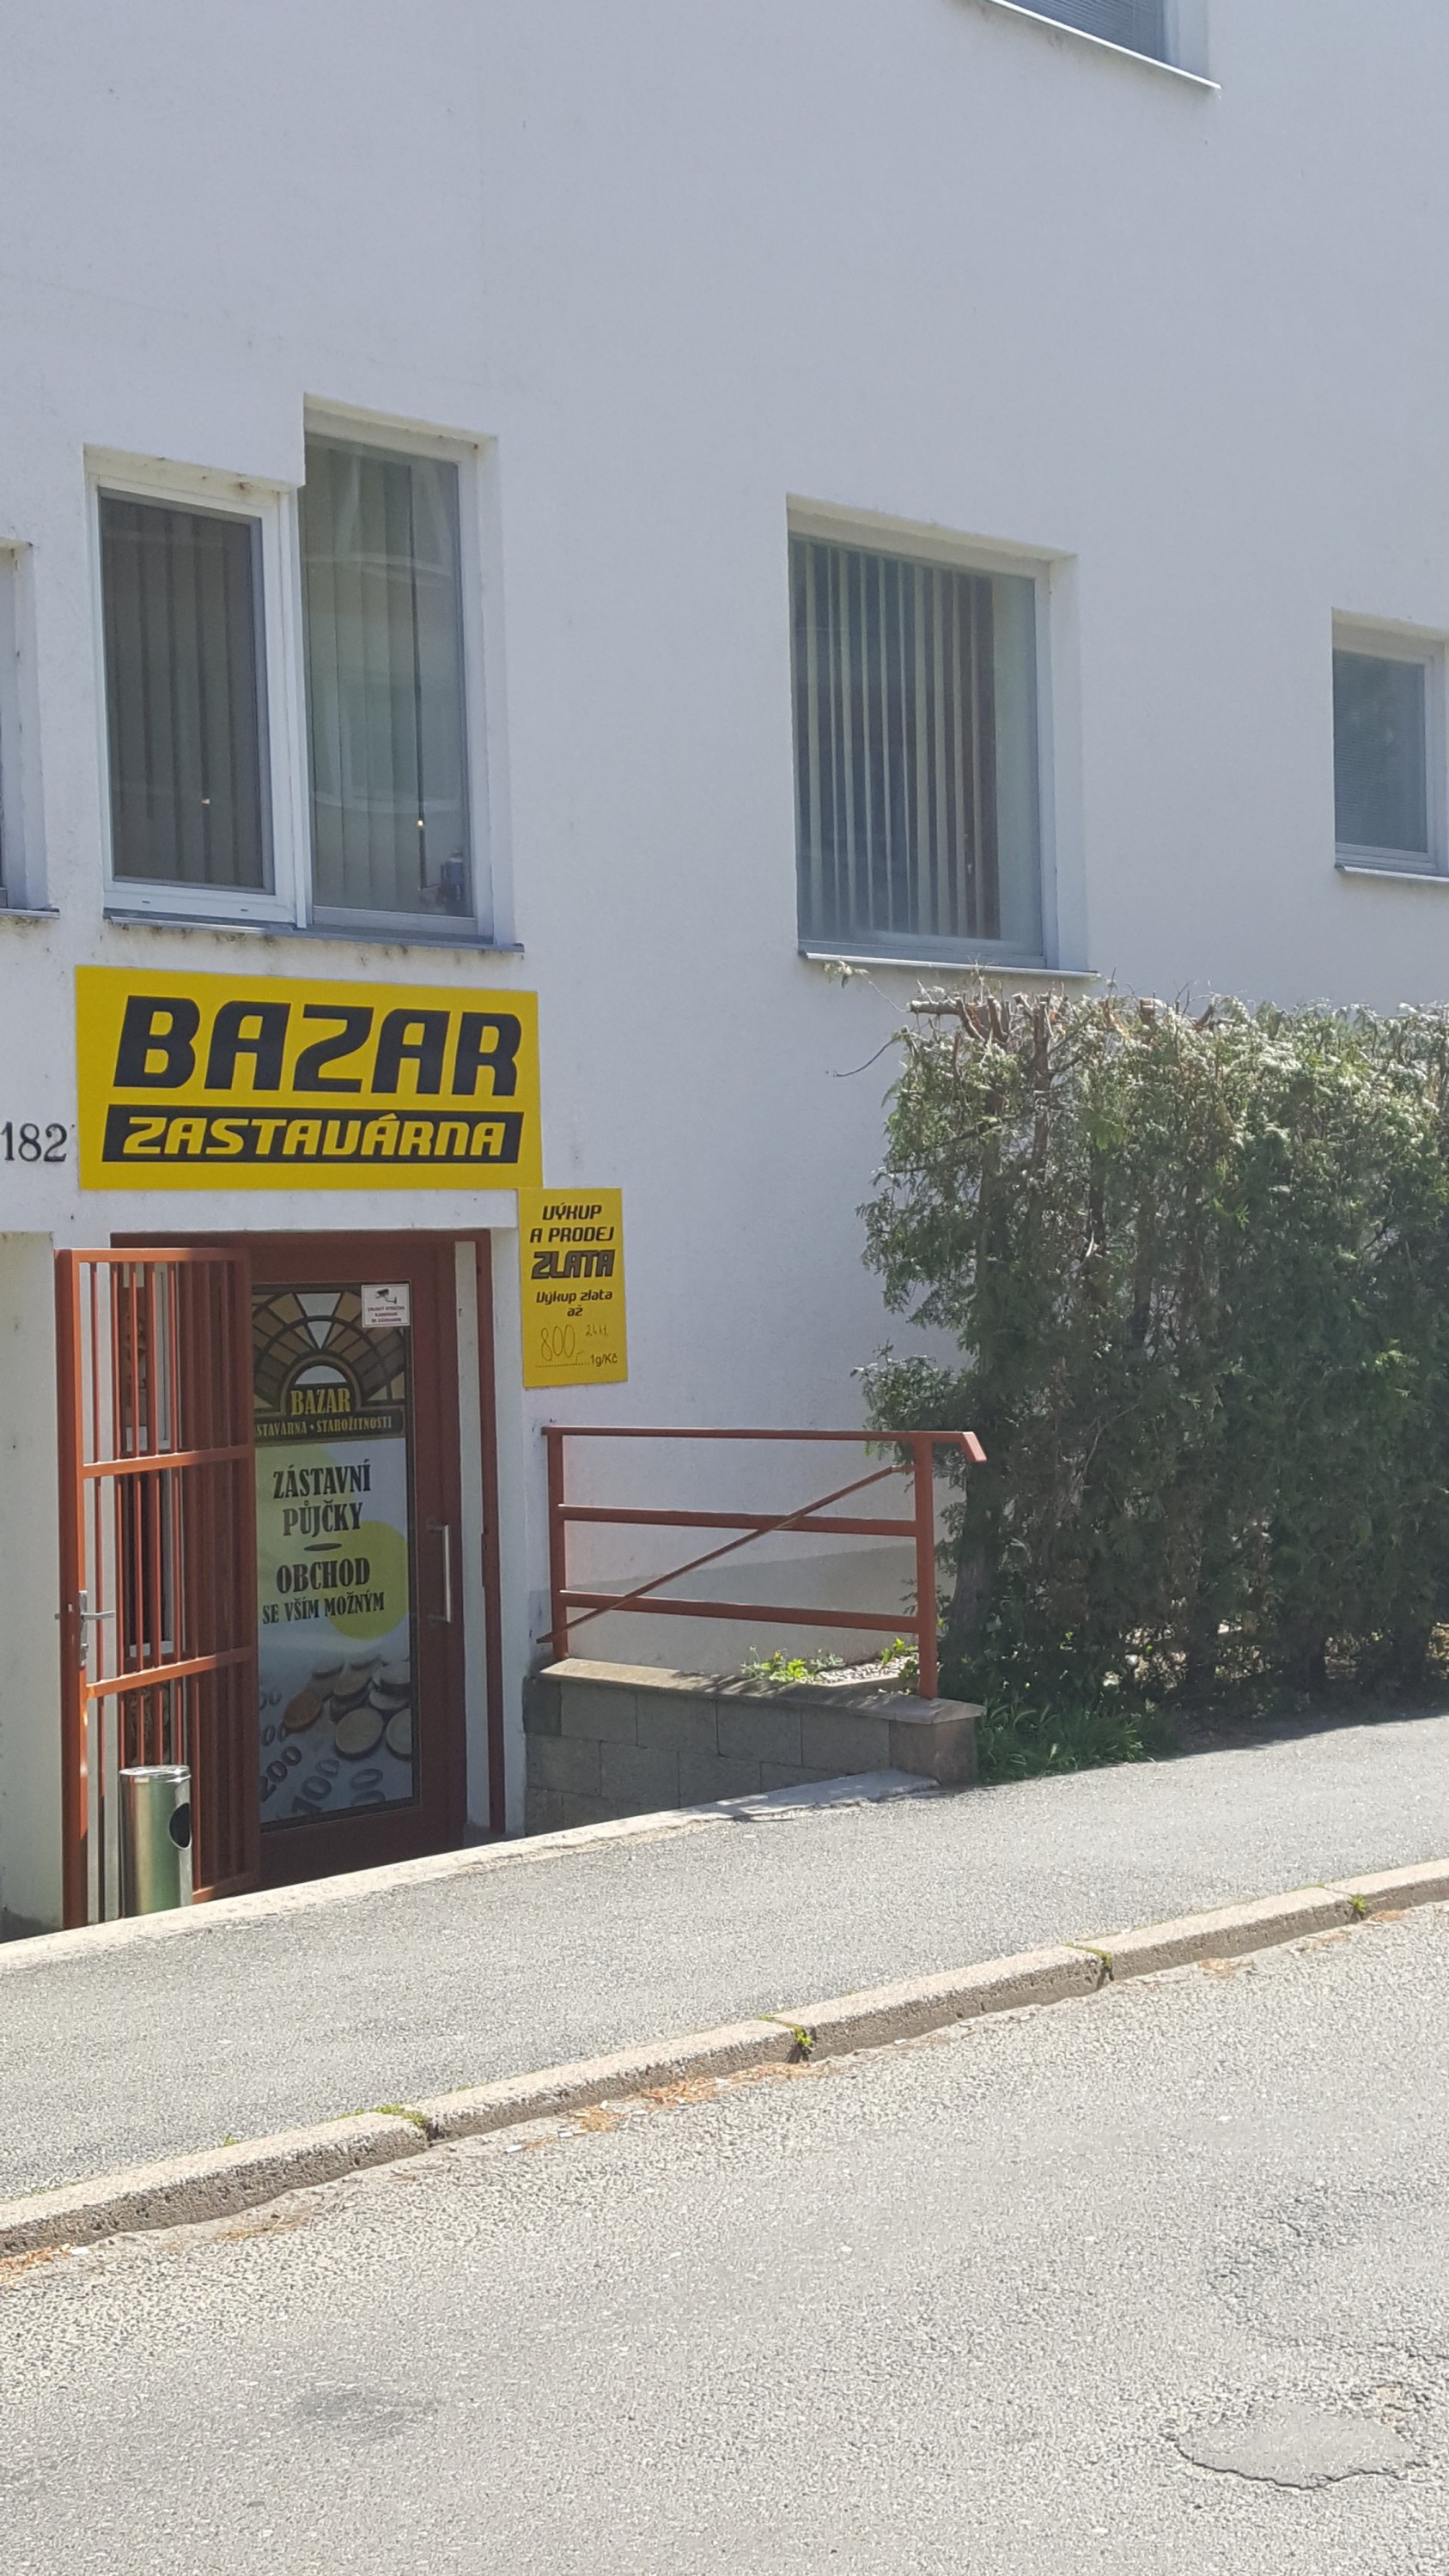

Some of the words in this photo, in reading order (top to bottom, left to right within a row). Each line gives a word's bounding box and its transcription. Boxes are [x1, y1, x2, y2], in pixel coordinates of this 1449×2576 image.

[113, 994, 522, 1097] BAZAR
[0, 1121, 67, 1162] 182
[122, 1113, 506, 1156] ZASTAVÁRNA
[542, 1202, 602, 1220] VÝKUP
[529, 1228, 543, 1243] A
[548, 1226, 615, 1242] PRODEJ
[531, 1249, 616, 1279] ZLATA
[536, 1290, 577, 1305] Výkup
[580, 1289, 613, 1302] zlata
[567, 1304, 583, 1316] až
[590, 1352, 618, 1367] 1g/Kč
[290, 1388, 351, 1415] BAZAR
[255, 1420, 307, 1437] STAVÁRNA
[316, 1416, 392, 1433] STAROŽITNOSTI
[273, 1459, 371, 1499] ZÁSTAVNÍ
[283, 1499, 363, 1537] PŮJČKY
[276, 1558, 370, 1594] OBCHOD
[262, 1604, 279, 1625] SE
[284, 1596, 320, 1622] VŠÍM
[324, 1590, 385, 1617] MOŽNÝM
